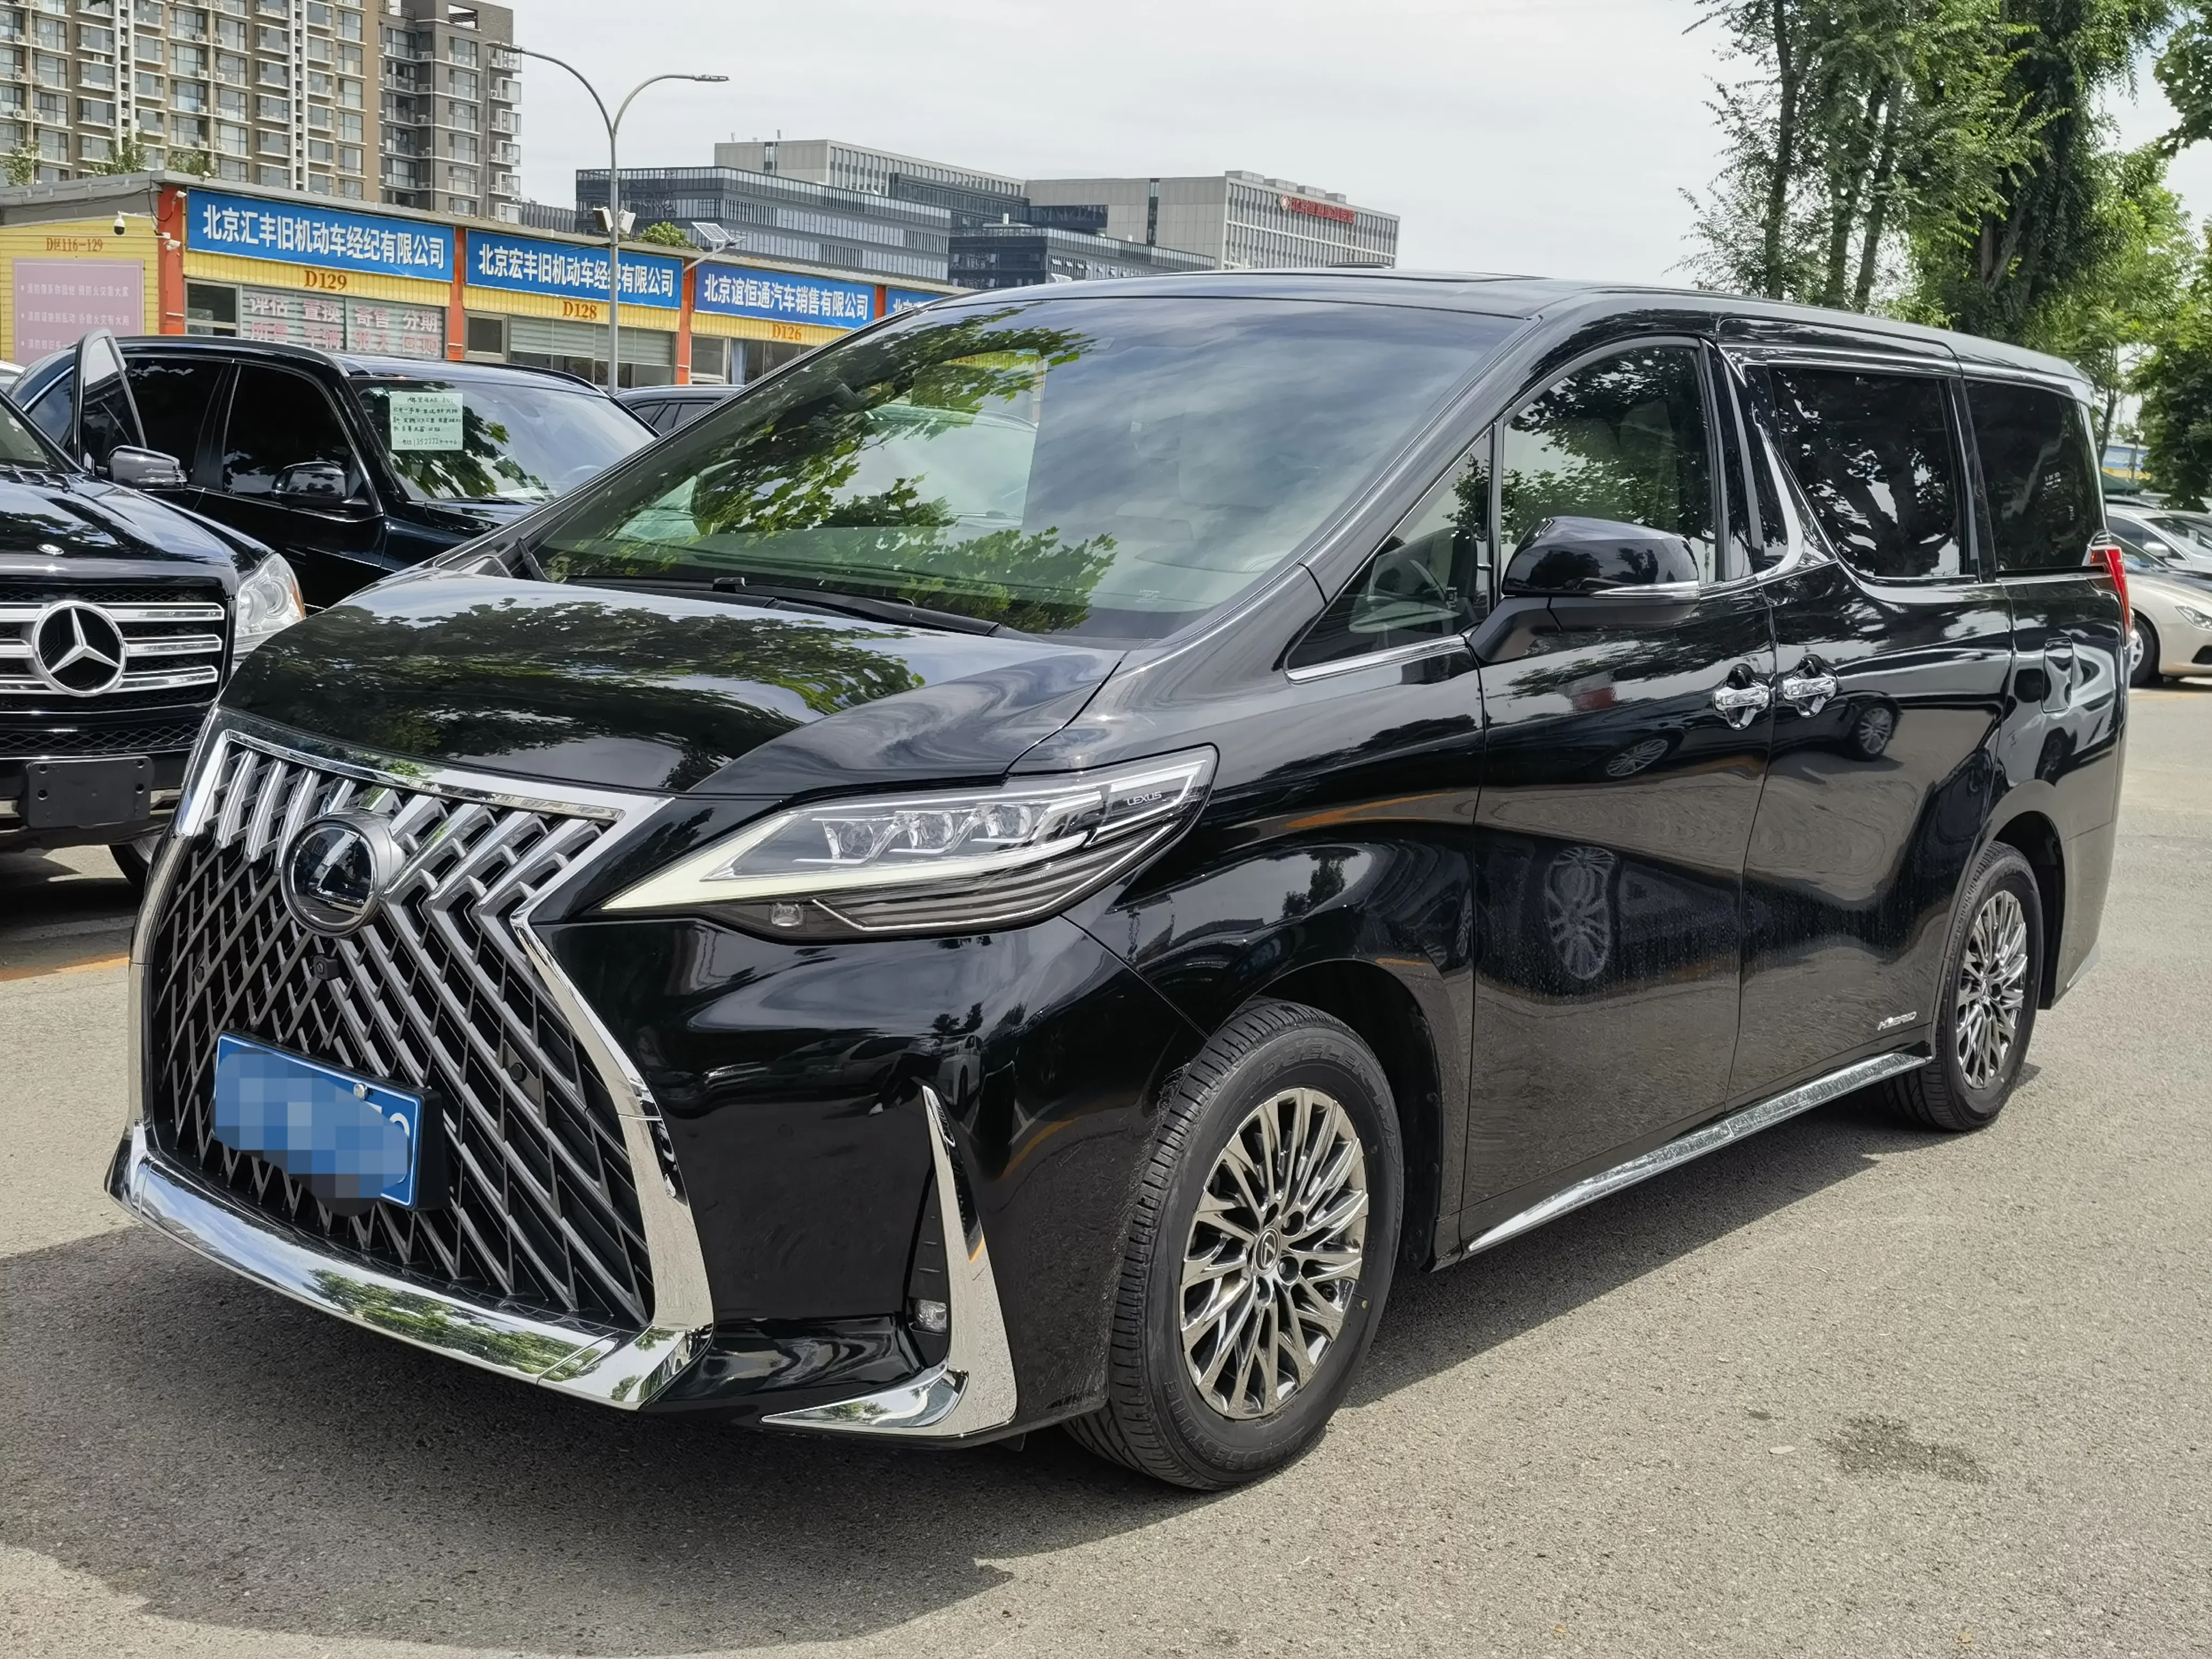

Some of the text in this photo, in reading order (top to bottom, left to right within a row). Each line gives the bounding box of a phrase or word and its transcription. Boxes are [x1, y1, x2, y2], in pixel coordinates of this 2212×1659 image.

[203, 204, 444, 269] 北京汇丰旧机动车经纪有限公司
[304, 270, 347, 290] D129
[704, 273, 868, 321] 北京谊恒通汽车销售有限公司
[249, 296, 439, 333] 评估 置换 寄售 分期
[563, 301, 597, 320] D128
[772, 323, 801, 341] D126
[1127, 791, 1162, 806] LEXUS
